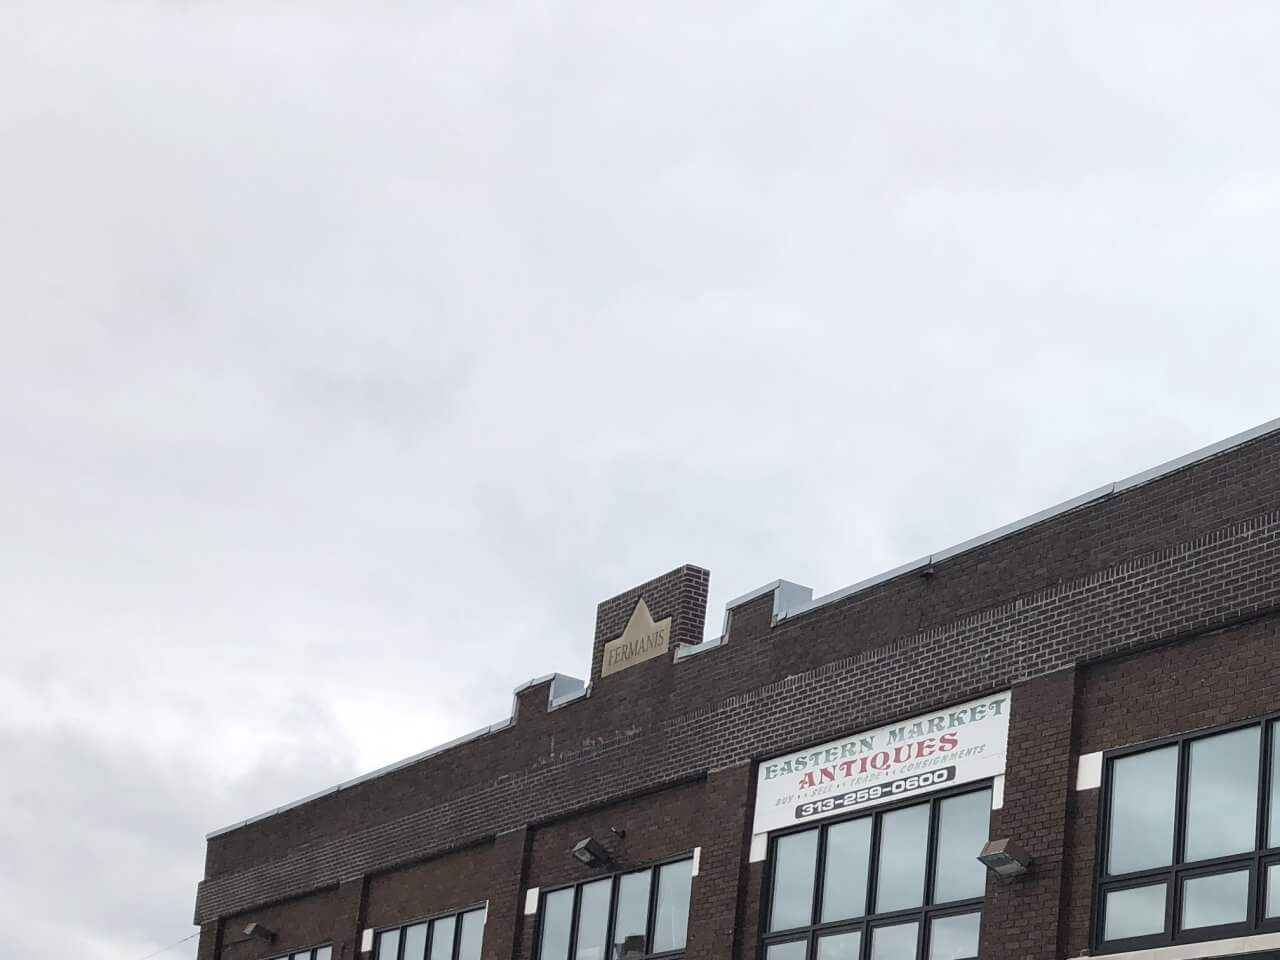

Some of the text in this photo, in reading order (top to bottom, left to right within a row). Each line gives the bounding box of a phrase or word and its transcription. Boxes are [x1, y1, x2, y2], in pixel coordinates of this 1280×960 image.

[764, 698, 1008, 780] EASTERN MARKET
[799, 731, 959, 790] ANTIQUES
[801, 768, 948, 817] 313-259-0600
